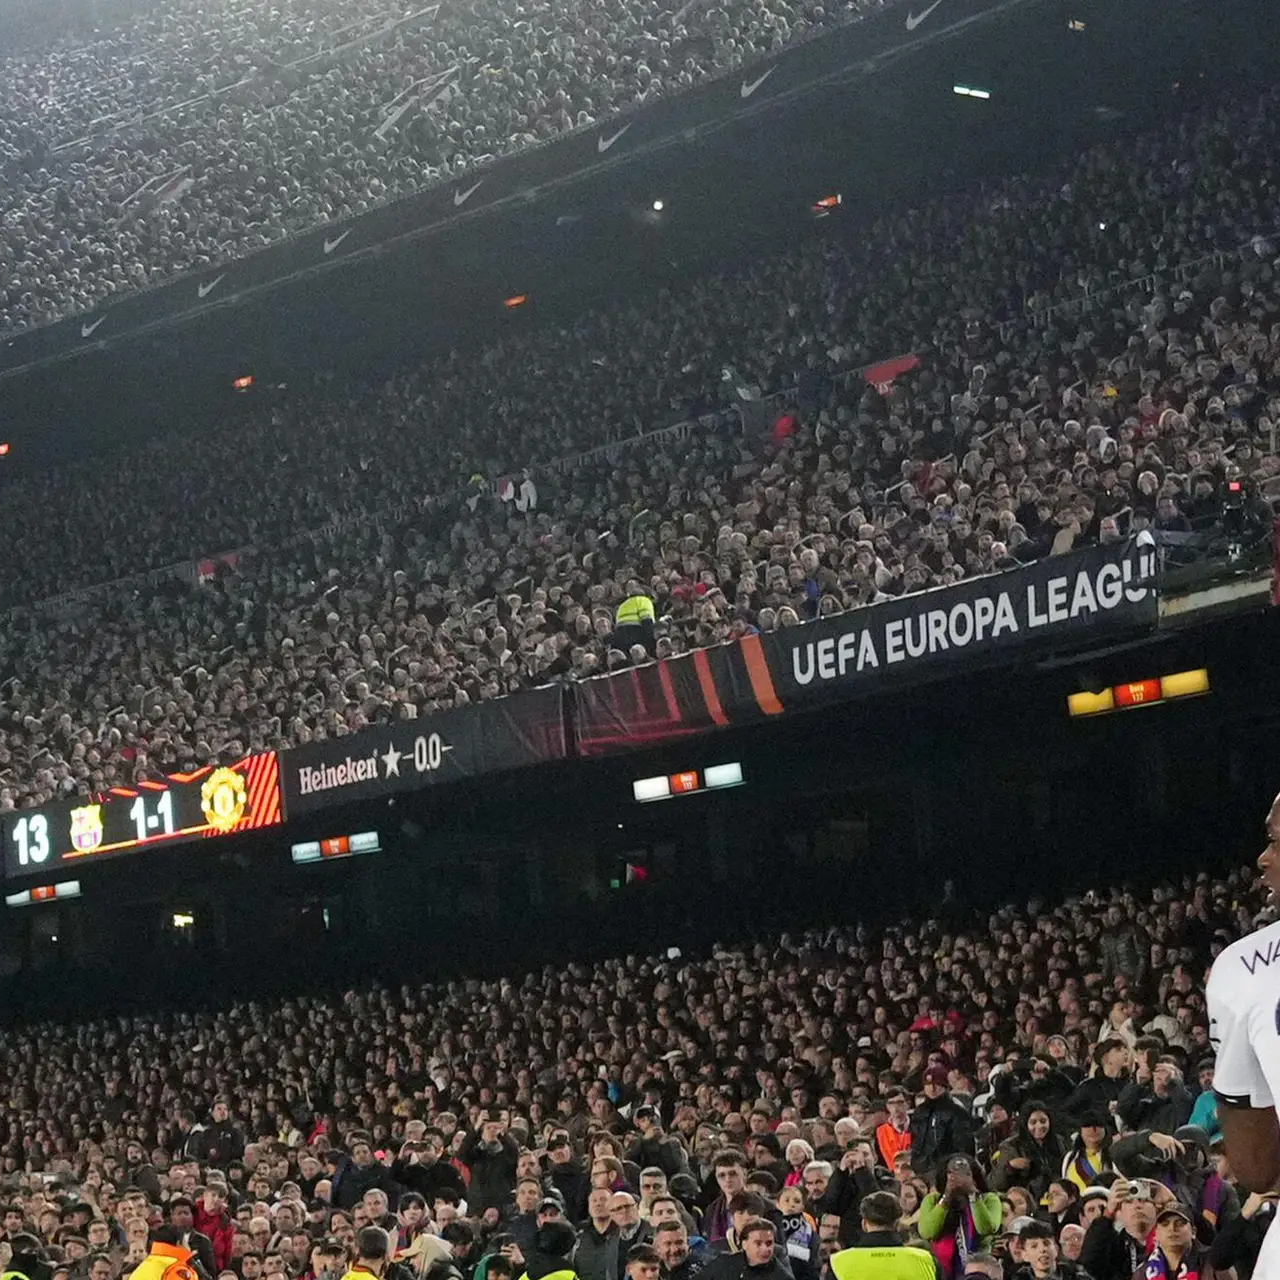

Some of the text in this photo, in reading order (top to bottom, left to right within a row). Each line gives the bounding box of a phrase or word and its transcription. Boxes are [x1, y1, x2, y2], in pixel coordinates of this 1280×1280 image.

[793, 553, 1157, 685] UEFA EUROPA LEAGU
[299, 754, 377, 795] Heineken
[12, 790, 174, 866] 13 1-1
